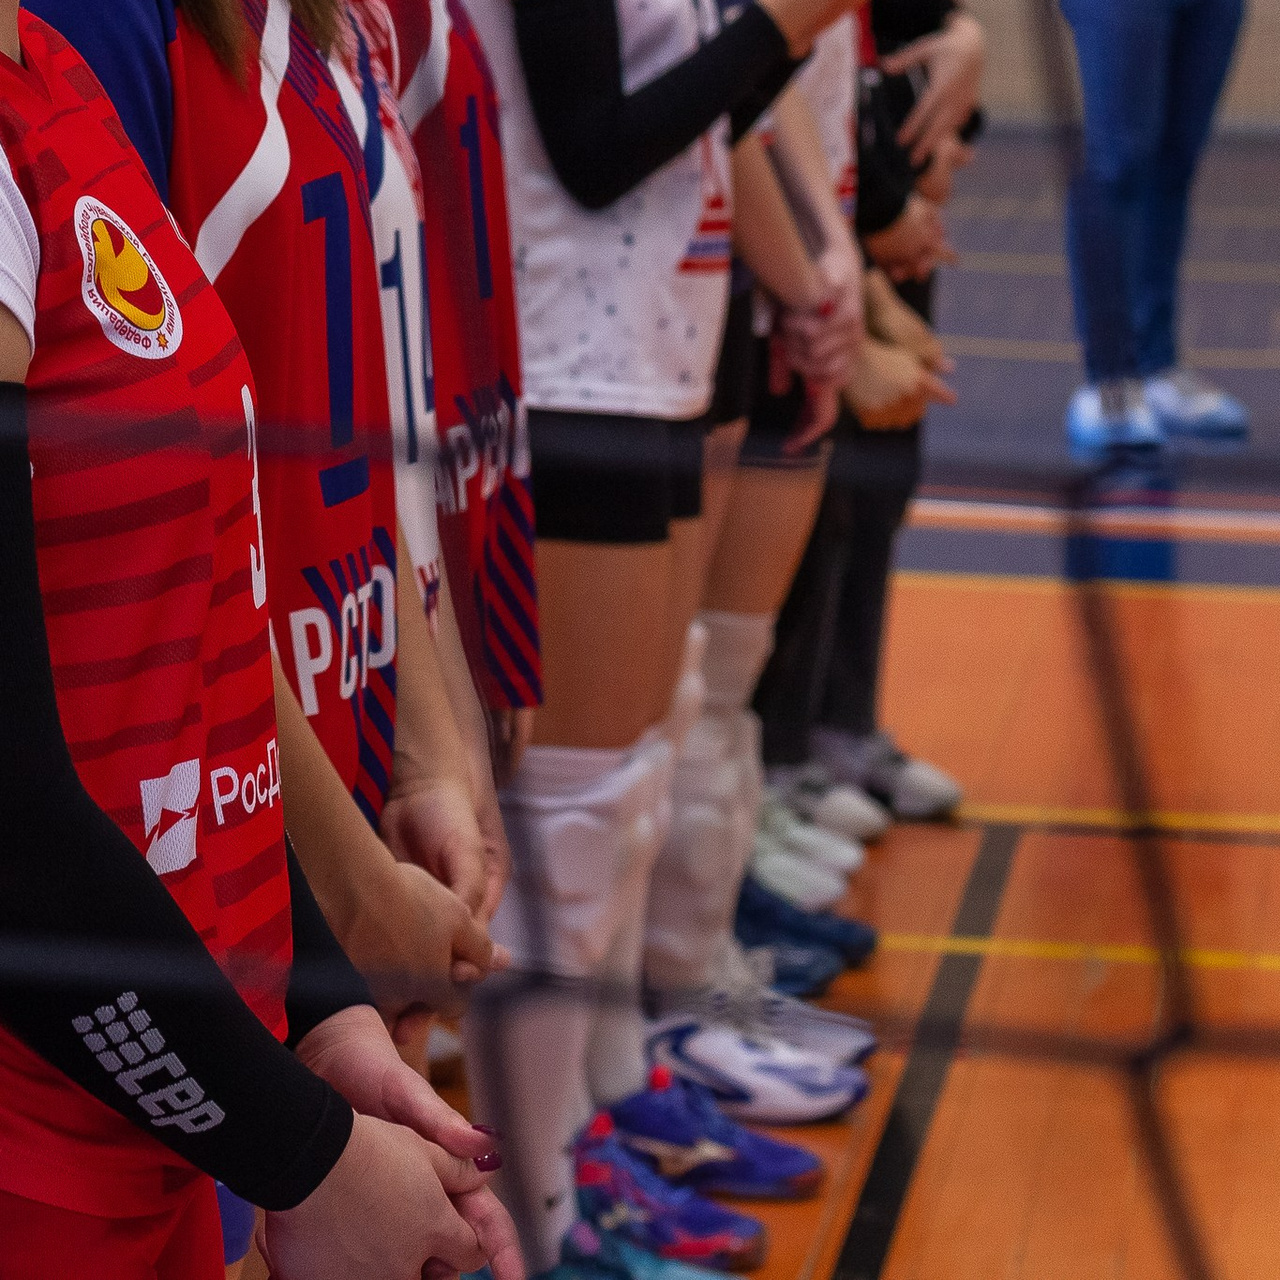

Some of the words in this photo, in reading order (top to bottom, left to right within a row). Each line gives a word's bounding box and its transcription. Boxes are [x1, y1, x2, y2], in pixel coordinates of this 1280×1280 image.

[78, 208, 95, 284] волейбола
[86, 288, 152, 350] Федерация
[142, 252, 177, 337] Республики
[210, 737, 282, 826] РосД
